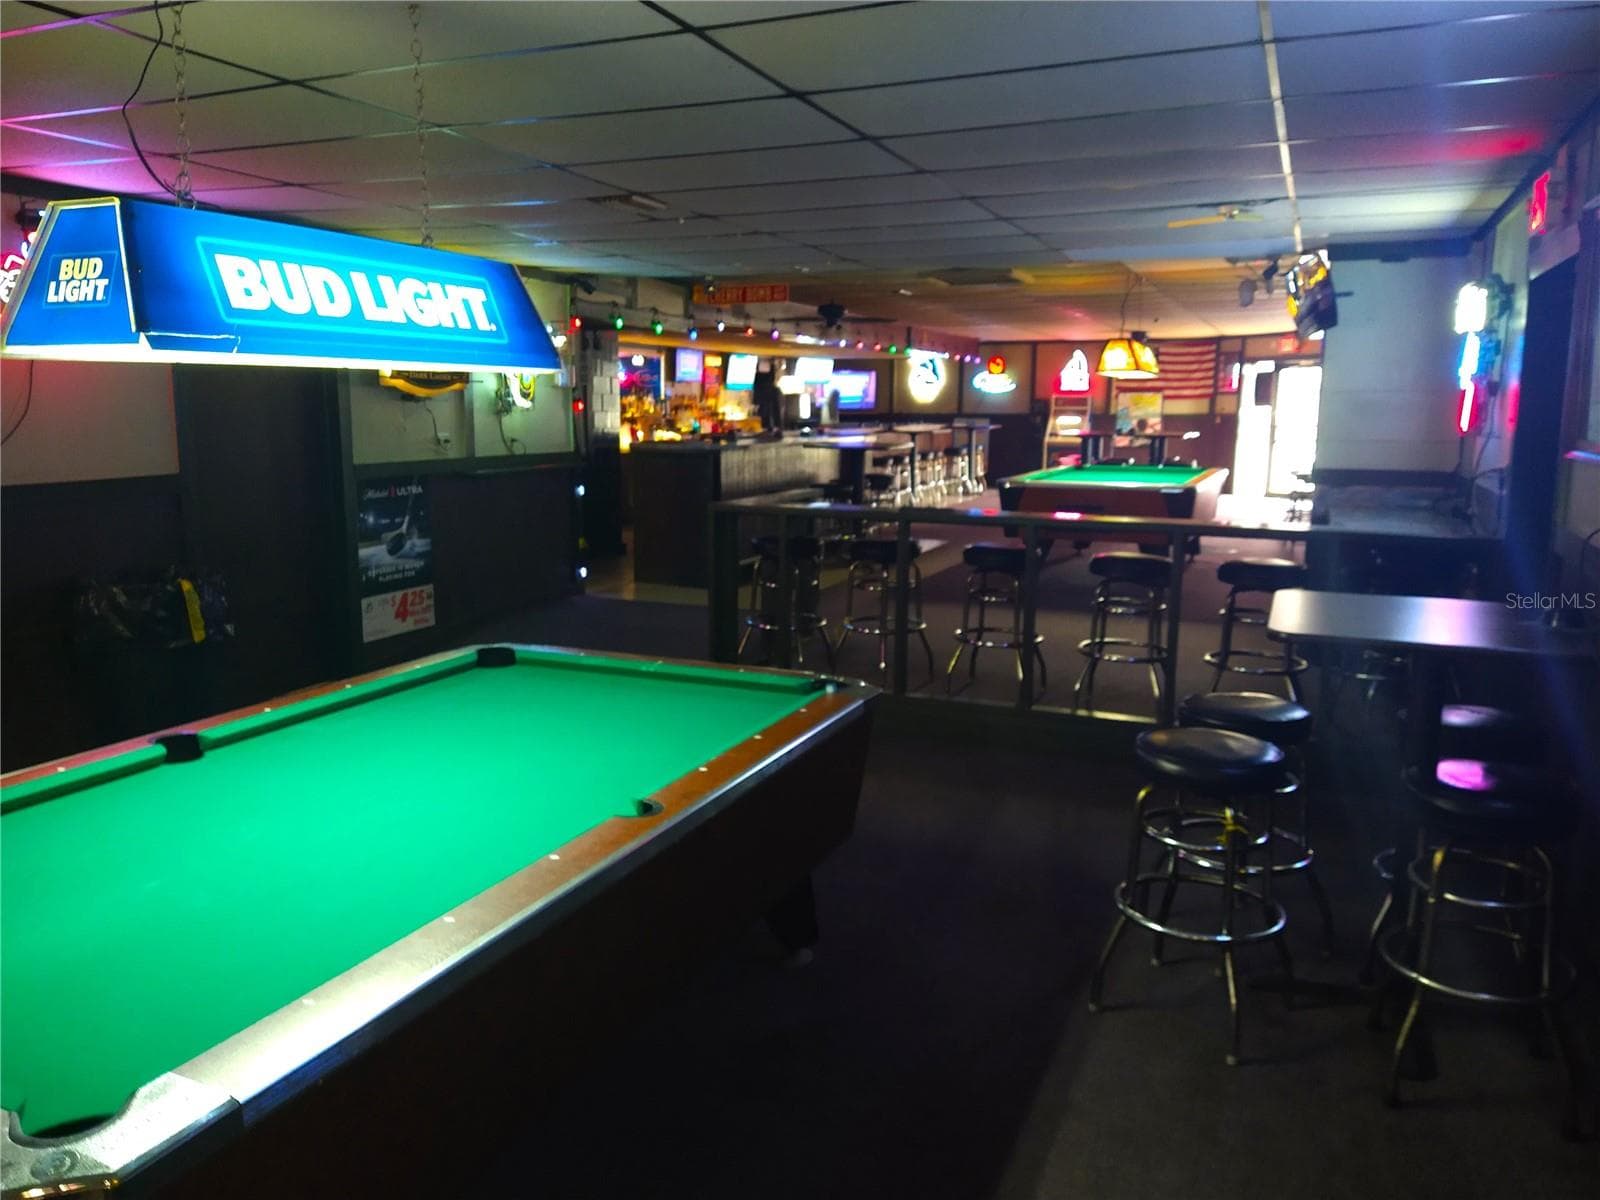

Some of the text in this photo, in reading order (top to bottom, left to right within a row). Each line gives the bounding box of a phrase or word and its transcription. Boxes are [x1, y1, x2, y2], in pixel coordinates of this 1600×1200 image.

[59, 257, 103, 280] BUD
[47, 278, 108, 303] LIGHT
[214, 253, 497, 332] BUD LIGHT
[396, 485, 423, 497] ULTRA
